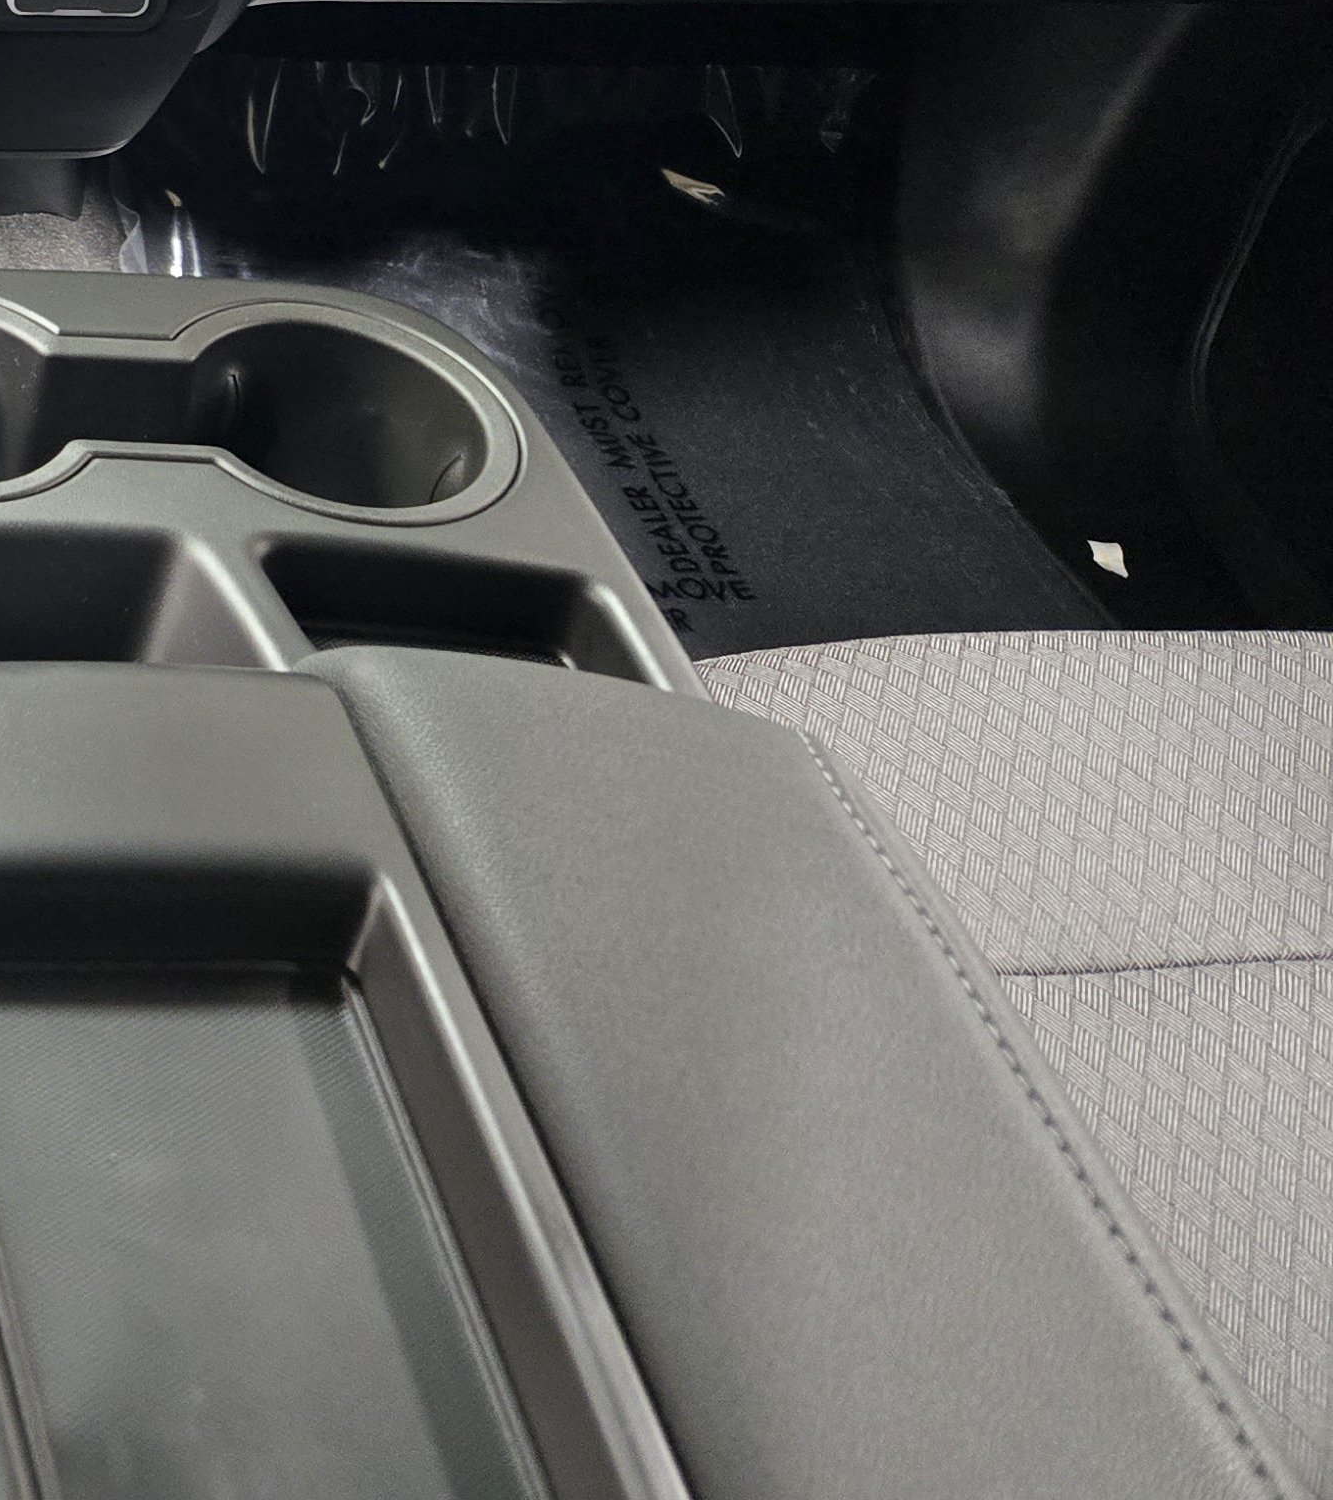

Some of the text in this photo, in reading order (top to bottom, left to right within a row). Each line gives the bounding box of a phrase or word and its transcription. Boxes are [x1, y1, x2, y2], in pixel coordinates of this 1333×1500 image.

[572, 399, 637, 470] MUST
[622, 485, 703, 574] DEALER
[626, 431, 740, 576] PROTECTIVE
